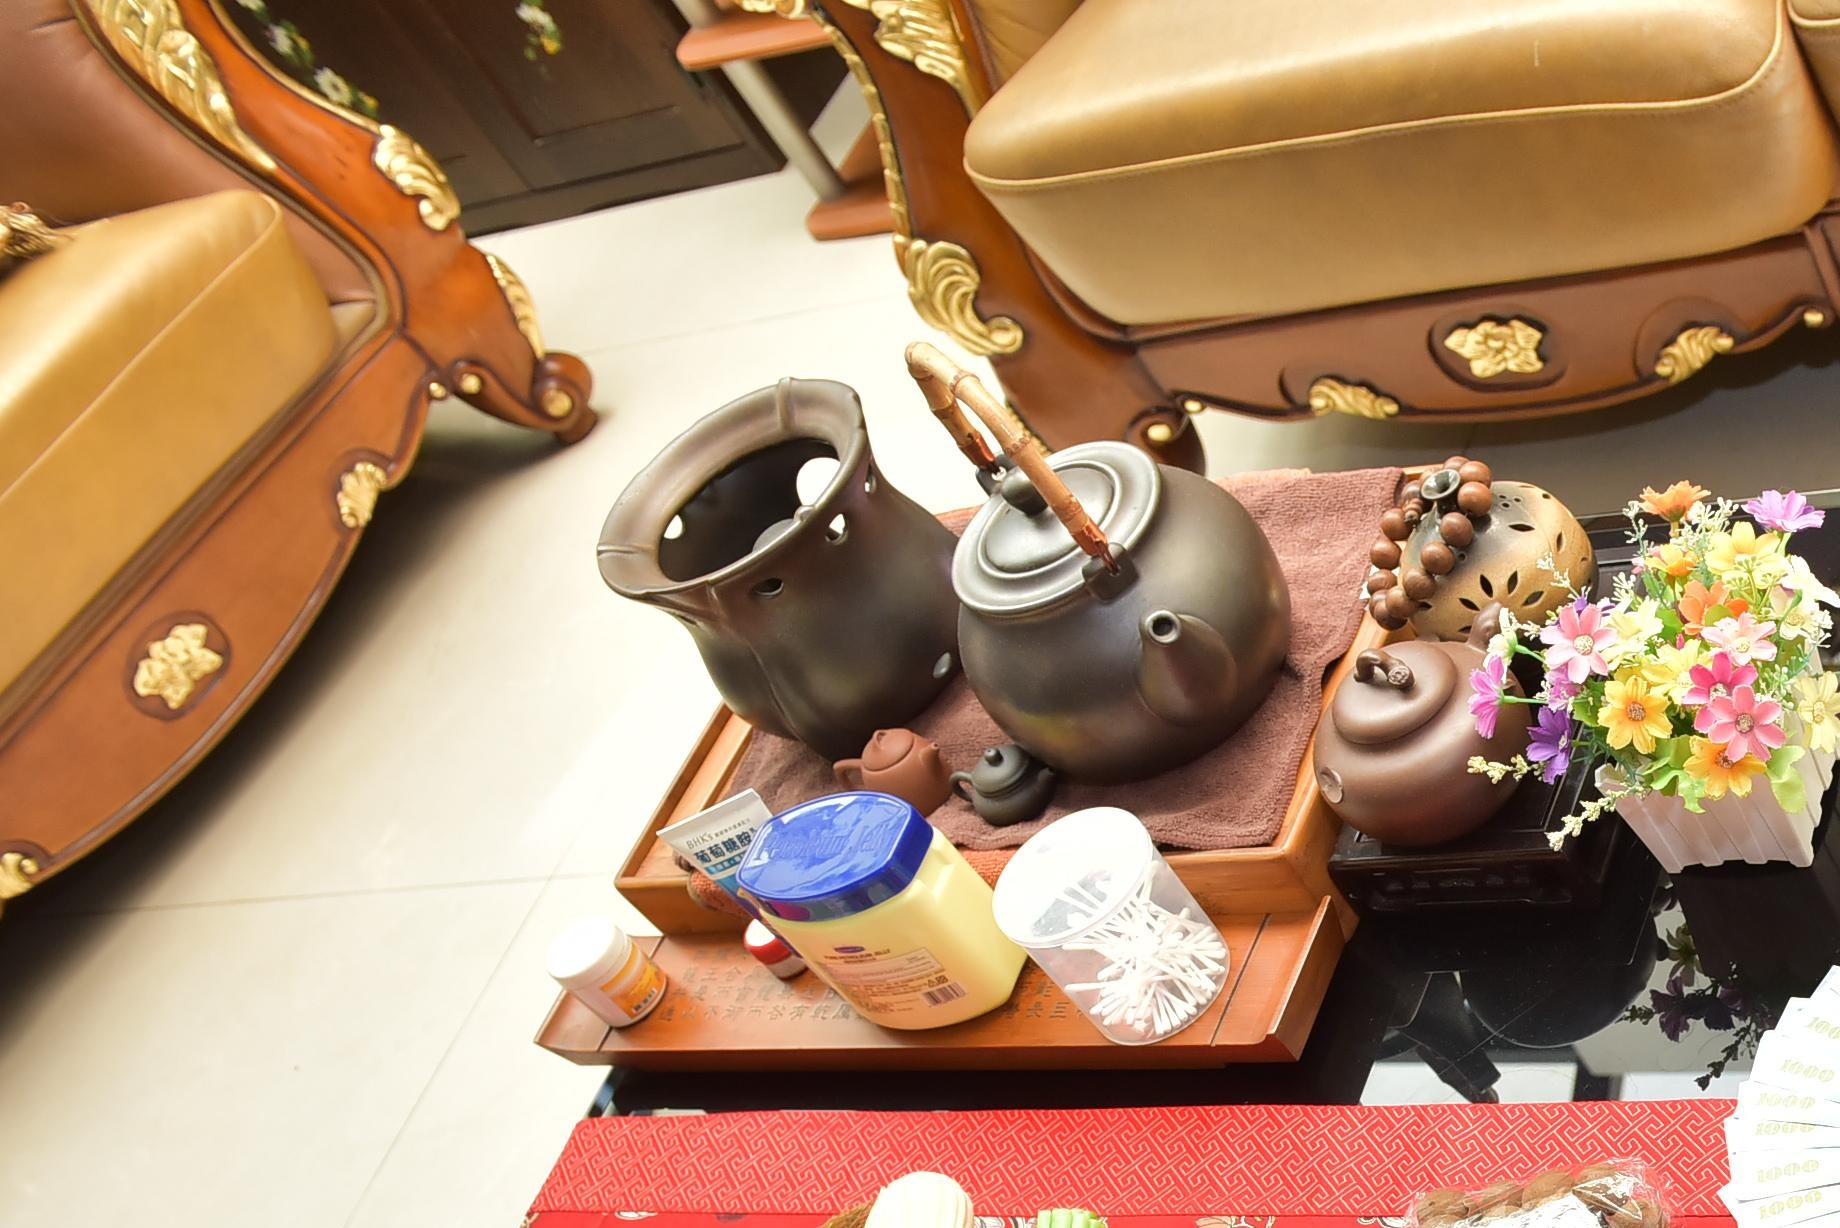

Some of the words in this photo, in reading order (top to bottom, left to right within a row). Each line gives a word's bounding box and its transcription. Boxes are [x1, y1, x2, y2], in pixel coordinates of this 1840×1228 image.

[1779, 1059, 1835, 1082] 1000
[1758, 1092, 1816, 1110] 1000
[1755, 1121, 1817, 1137] 1000
[1757, 1159, 1819, 1183] 1000
[1759, 1190, 1823, 1220] 1000
